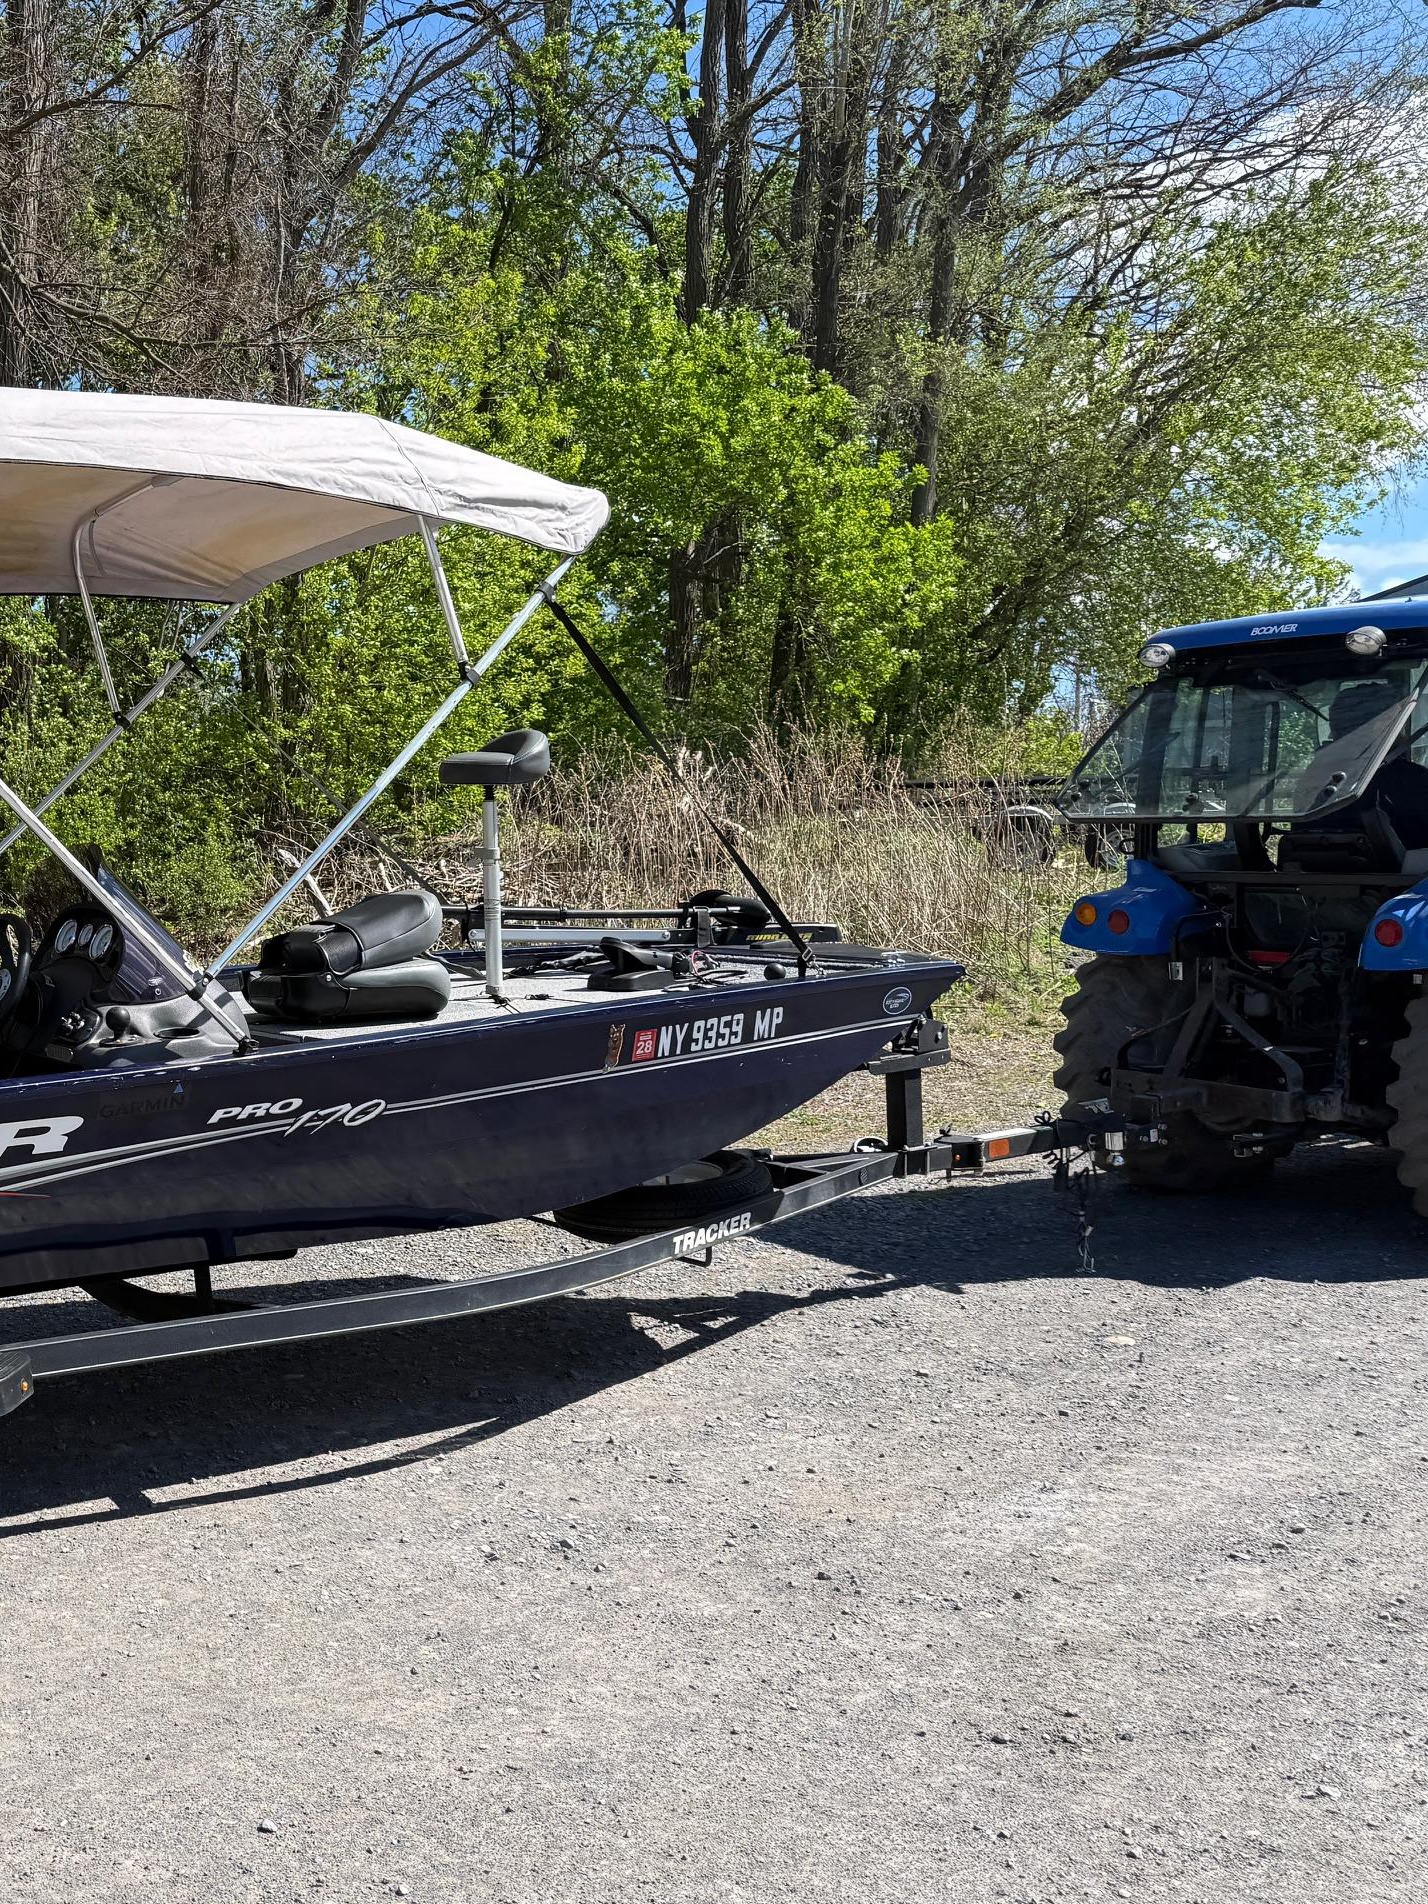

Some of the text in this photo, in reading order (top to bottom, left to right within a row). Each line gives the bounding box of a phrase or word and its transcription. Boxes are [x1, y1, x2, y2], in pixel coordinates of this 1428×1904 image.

[1250, 623, 1298, 636] BOOMER
[636, 1039, 654, 1055] 28
[657, 1006, 784, 1057] NY 9359 MP
[99, 1096, 184, 1118] GARMIN
[206, 1097, 387, 1138] PRO 170
[672, 1211, 752, 1255] TRACKER
